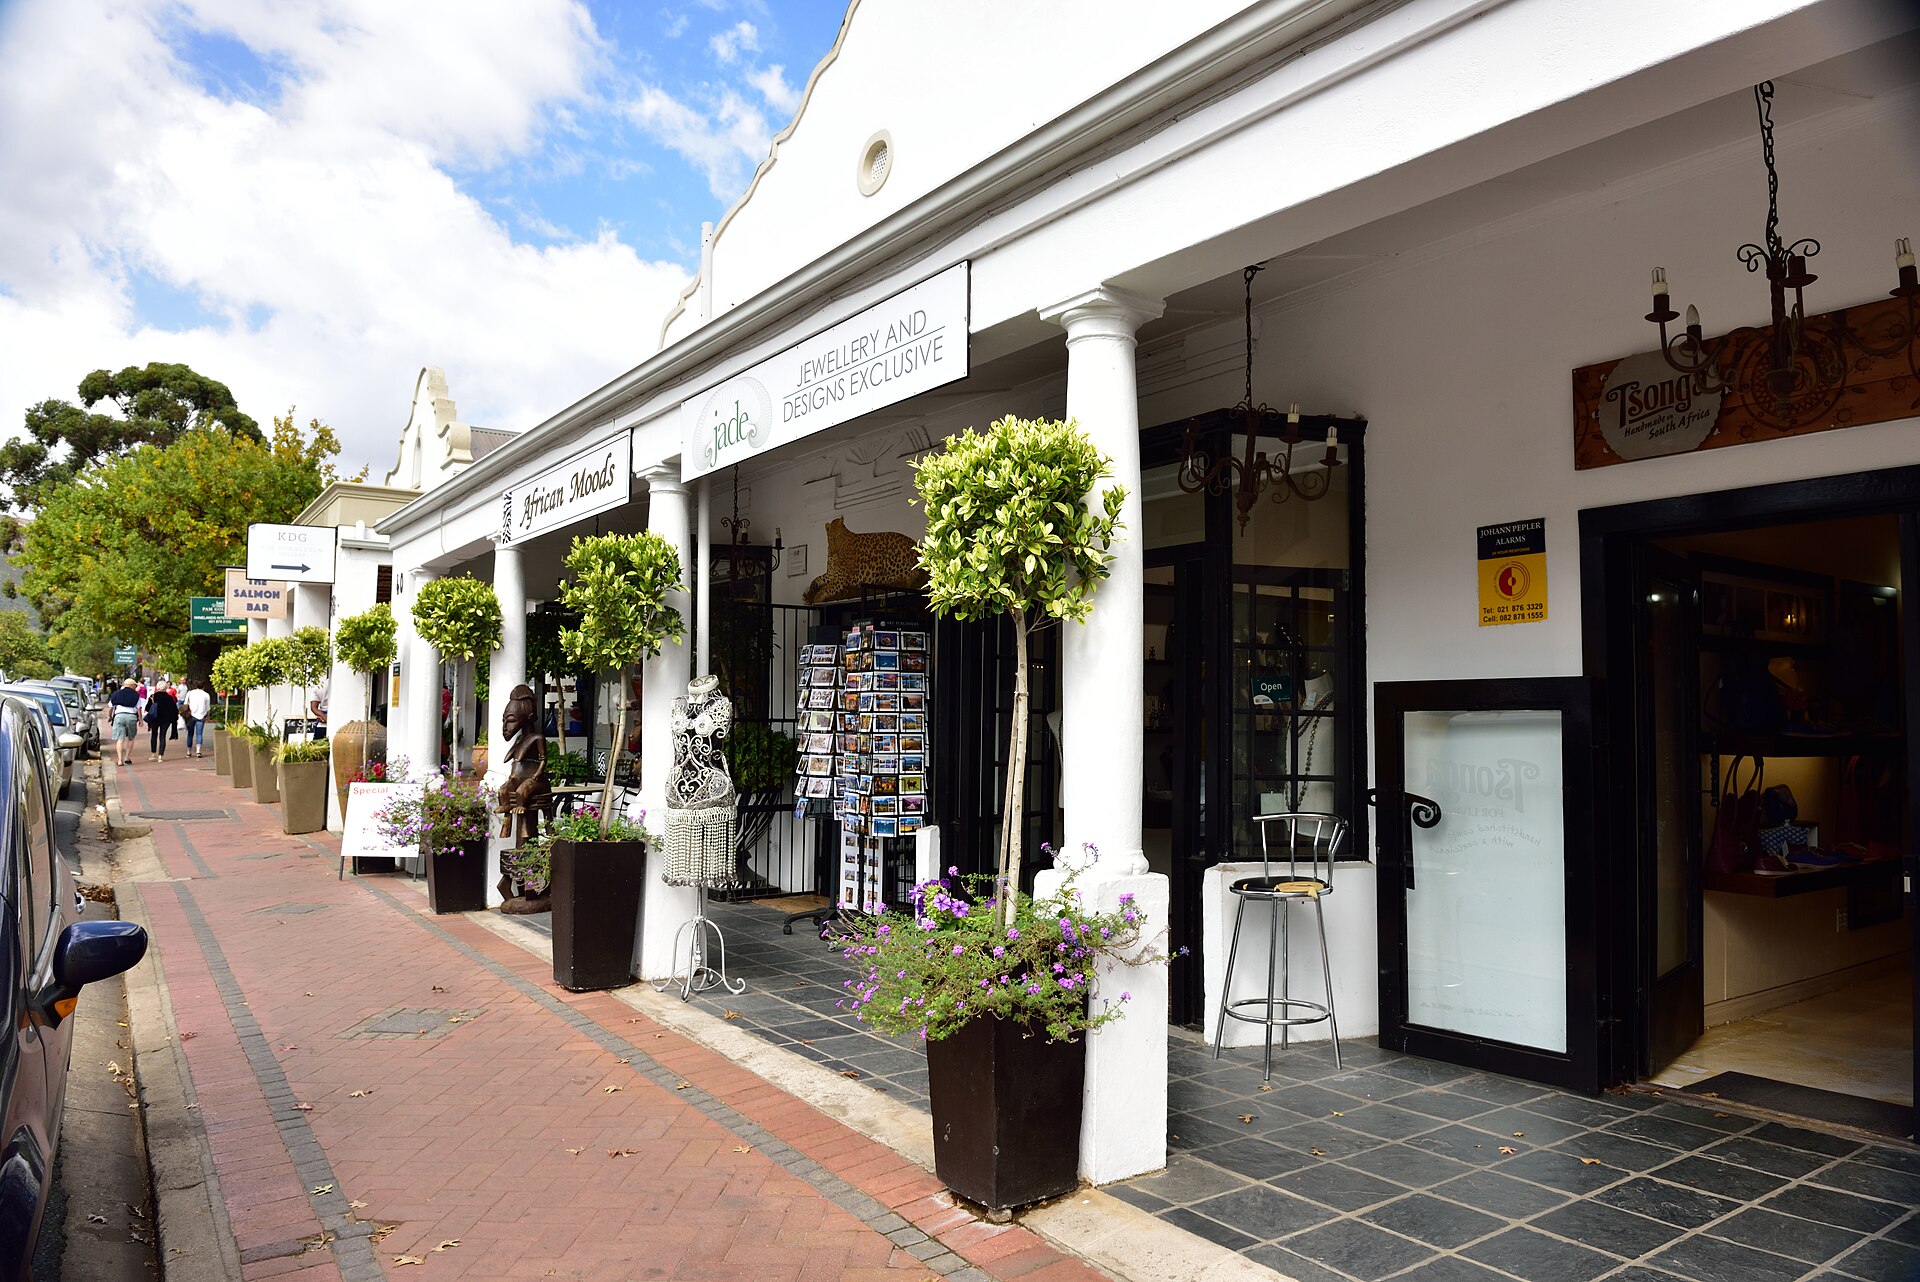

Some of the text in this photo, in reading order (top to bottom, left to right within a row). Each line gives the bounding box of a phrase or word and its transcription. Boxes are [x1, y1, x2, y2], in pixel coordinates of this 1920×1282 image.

[797, 309, 927, 388] JEWELLERY AND
[783, 335, 944, 424] DESIGNS EXCLUSIVE
[1624, 414, 1666, 438] Handmade
[1648, 408, 1711, 440] South Africa
[709, 399, 750, 468] jade
[519, 452, 616, 530] African Moods
[1479, 522, 1541, 538] JOHANN PEPLER
[277, 531, 308, 543] KDG
[1495, 534, 1526, 546] ALARMS
[233, 589, 280, 599] SALMON
[246, 603, 269, 612] BAR
[1512, 604, 1524, 612] 876
[1526, 602, 1543, 611] 3329
[1482, 611, 1544, 623] Cell: 082 878 1555
[1260, 682, 1283, 693] Open
[353, 786, 389, 796] Special
